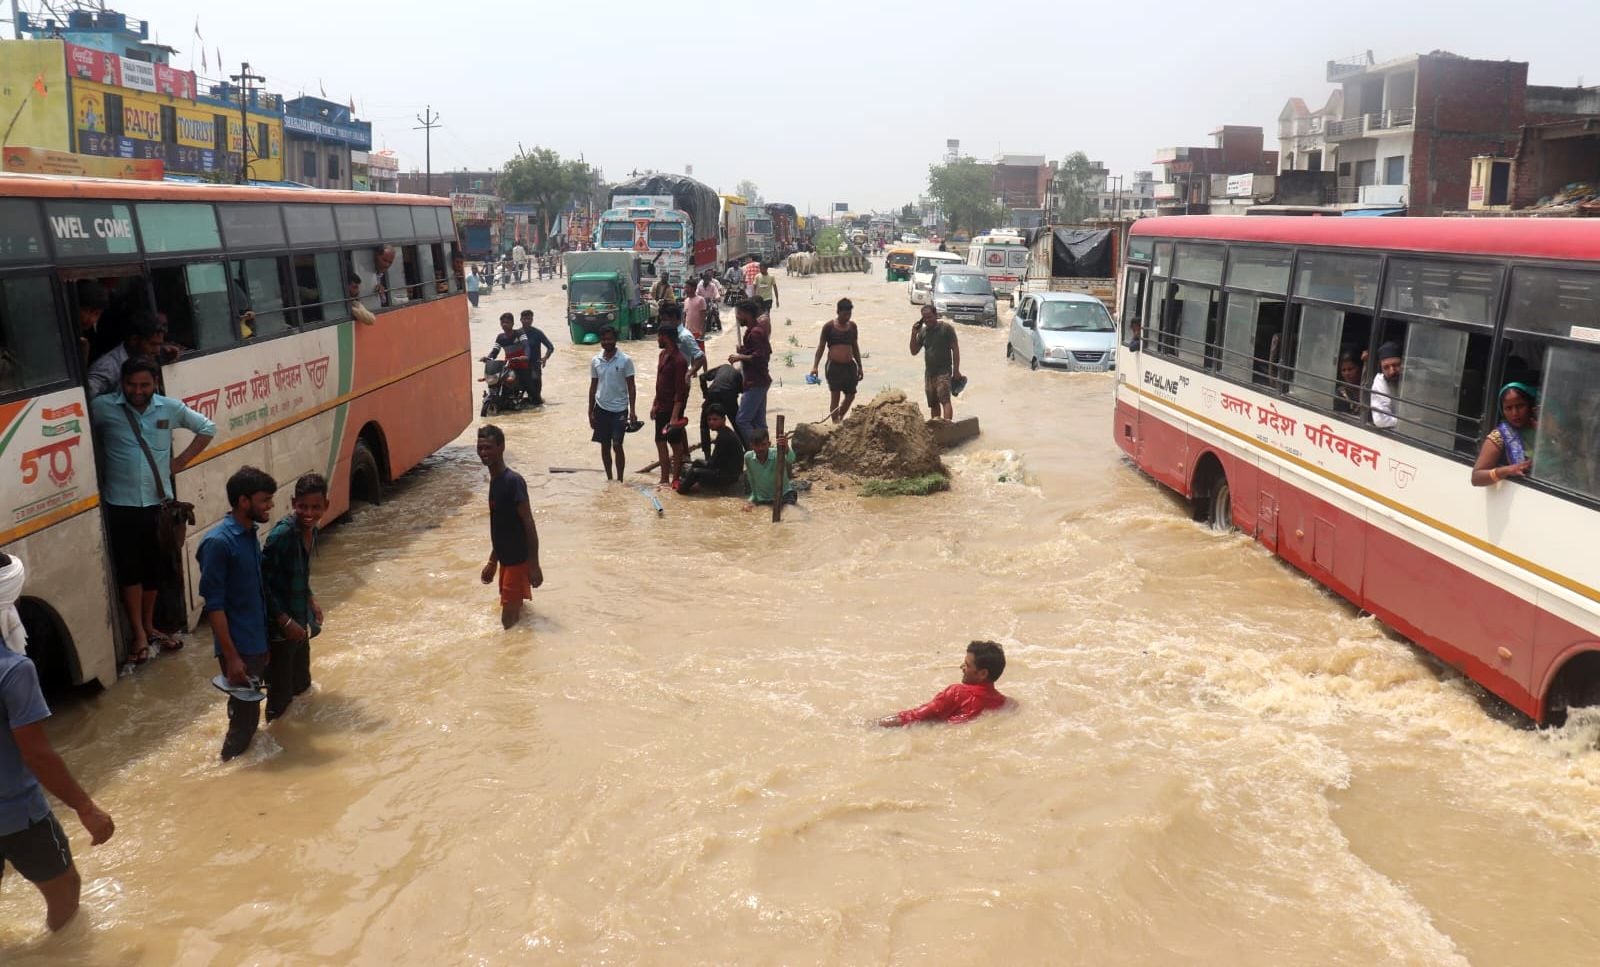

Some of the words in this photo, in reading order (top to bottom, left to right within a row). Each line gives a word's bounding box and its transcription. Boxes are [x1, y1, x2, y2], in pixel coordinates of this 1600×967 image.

[124, 106, 160, 138] FAUJI
[177, 116, 214, 143] TOURIST
[49, 216, 90, 239] WEL
[93, 217, 132, 239] COME
[224, 381, 248, 409] उत्तर
[249, 370, 271, 400] प्रदेश
[273, 363, 302, 391] परिवहन
[1144, 370, 1179, 395] SKYLINE
[1220, 392, 1253, 419] उत्तर
[1256, 403, 1297, 437] प्रदेश
[1304, 423, 1381, 470] परिवहन
